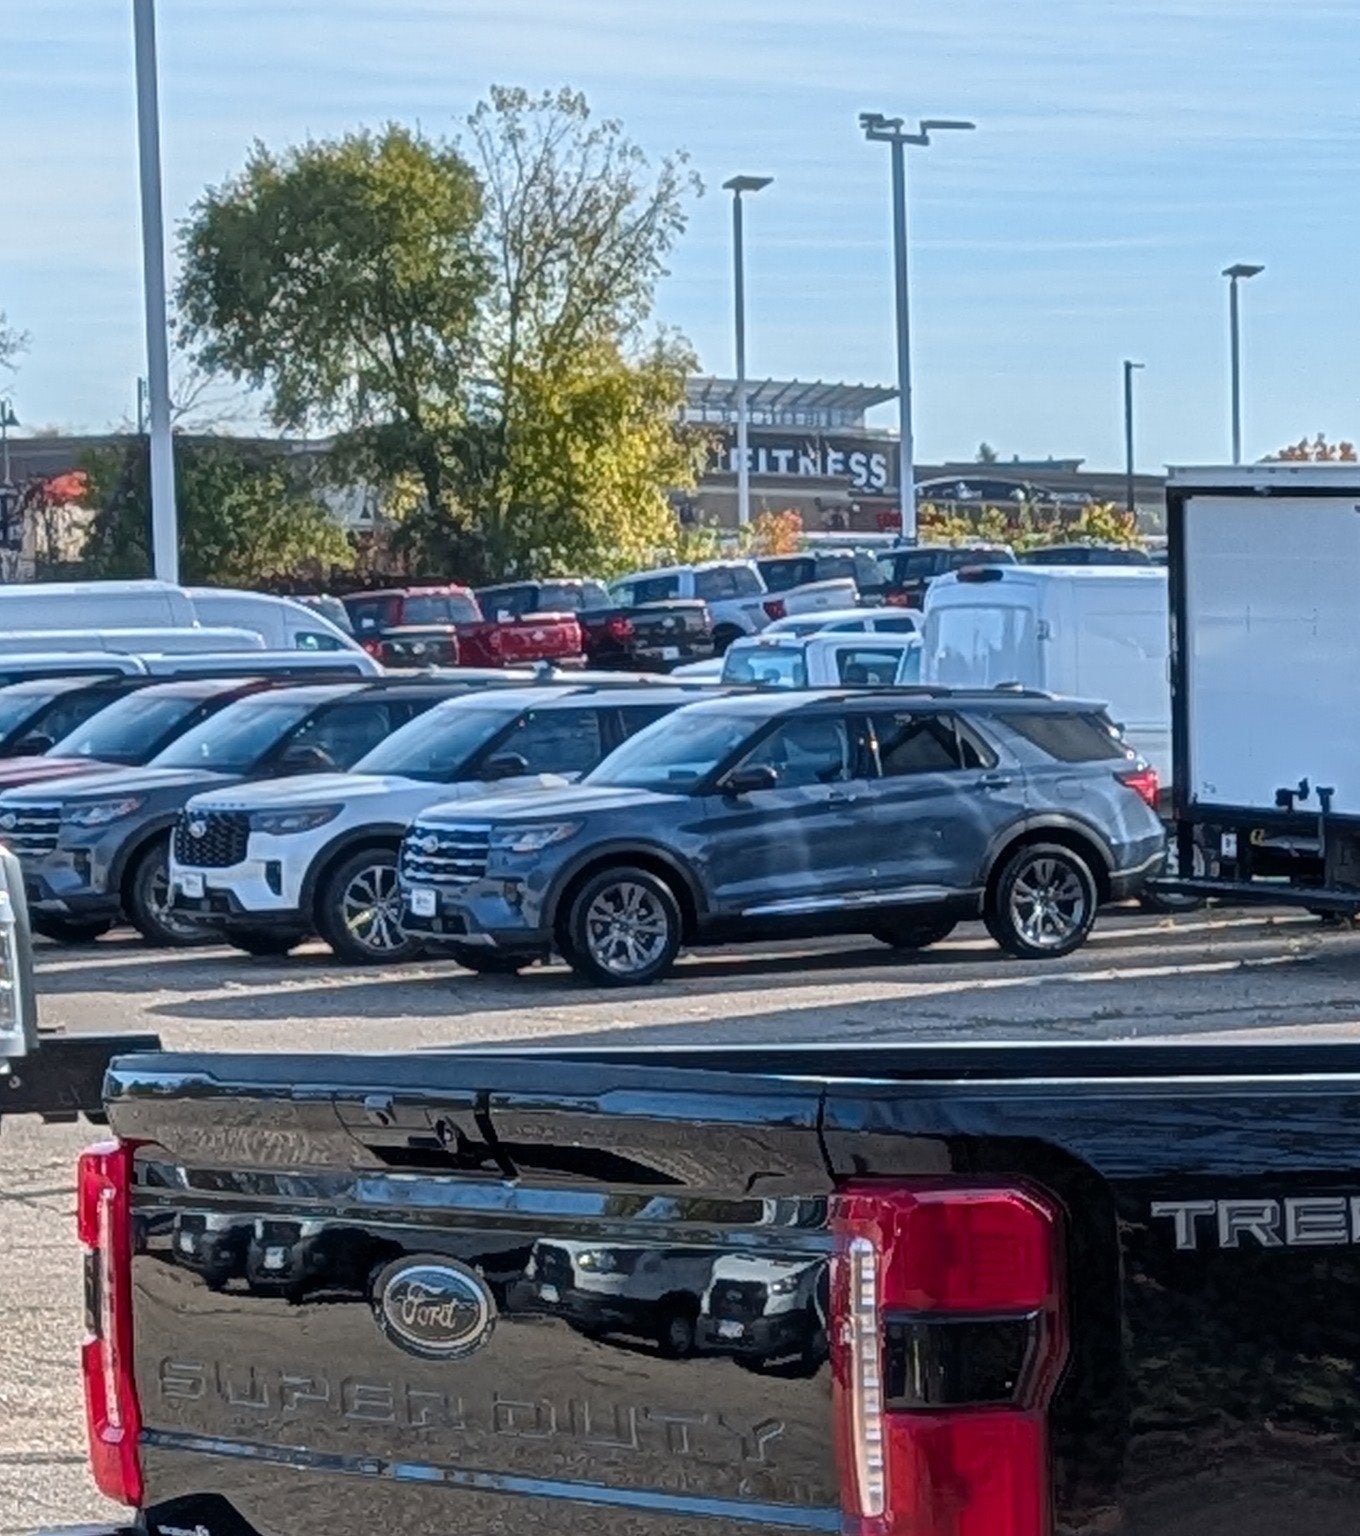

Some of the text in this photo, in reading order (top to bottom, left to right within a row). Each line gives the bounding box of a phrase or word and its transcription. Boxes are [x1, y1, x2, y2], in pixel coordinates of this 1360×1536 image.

[729, 446, 887, 487] FITNESS
[395, 1283, 458, 1329] Ford
[158, 1357, 787, 1463] SUPER DUTY
